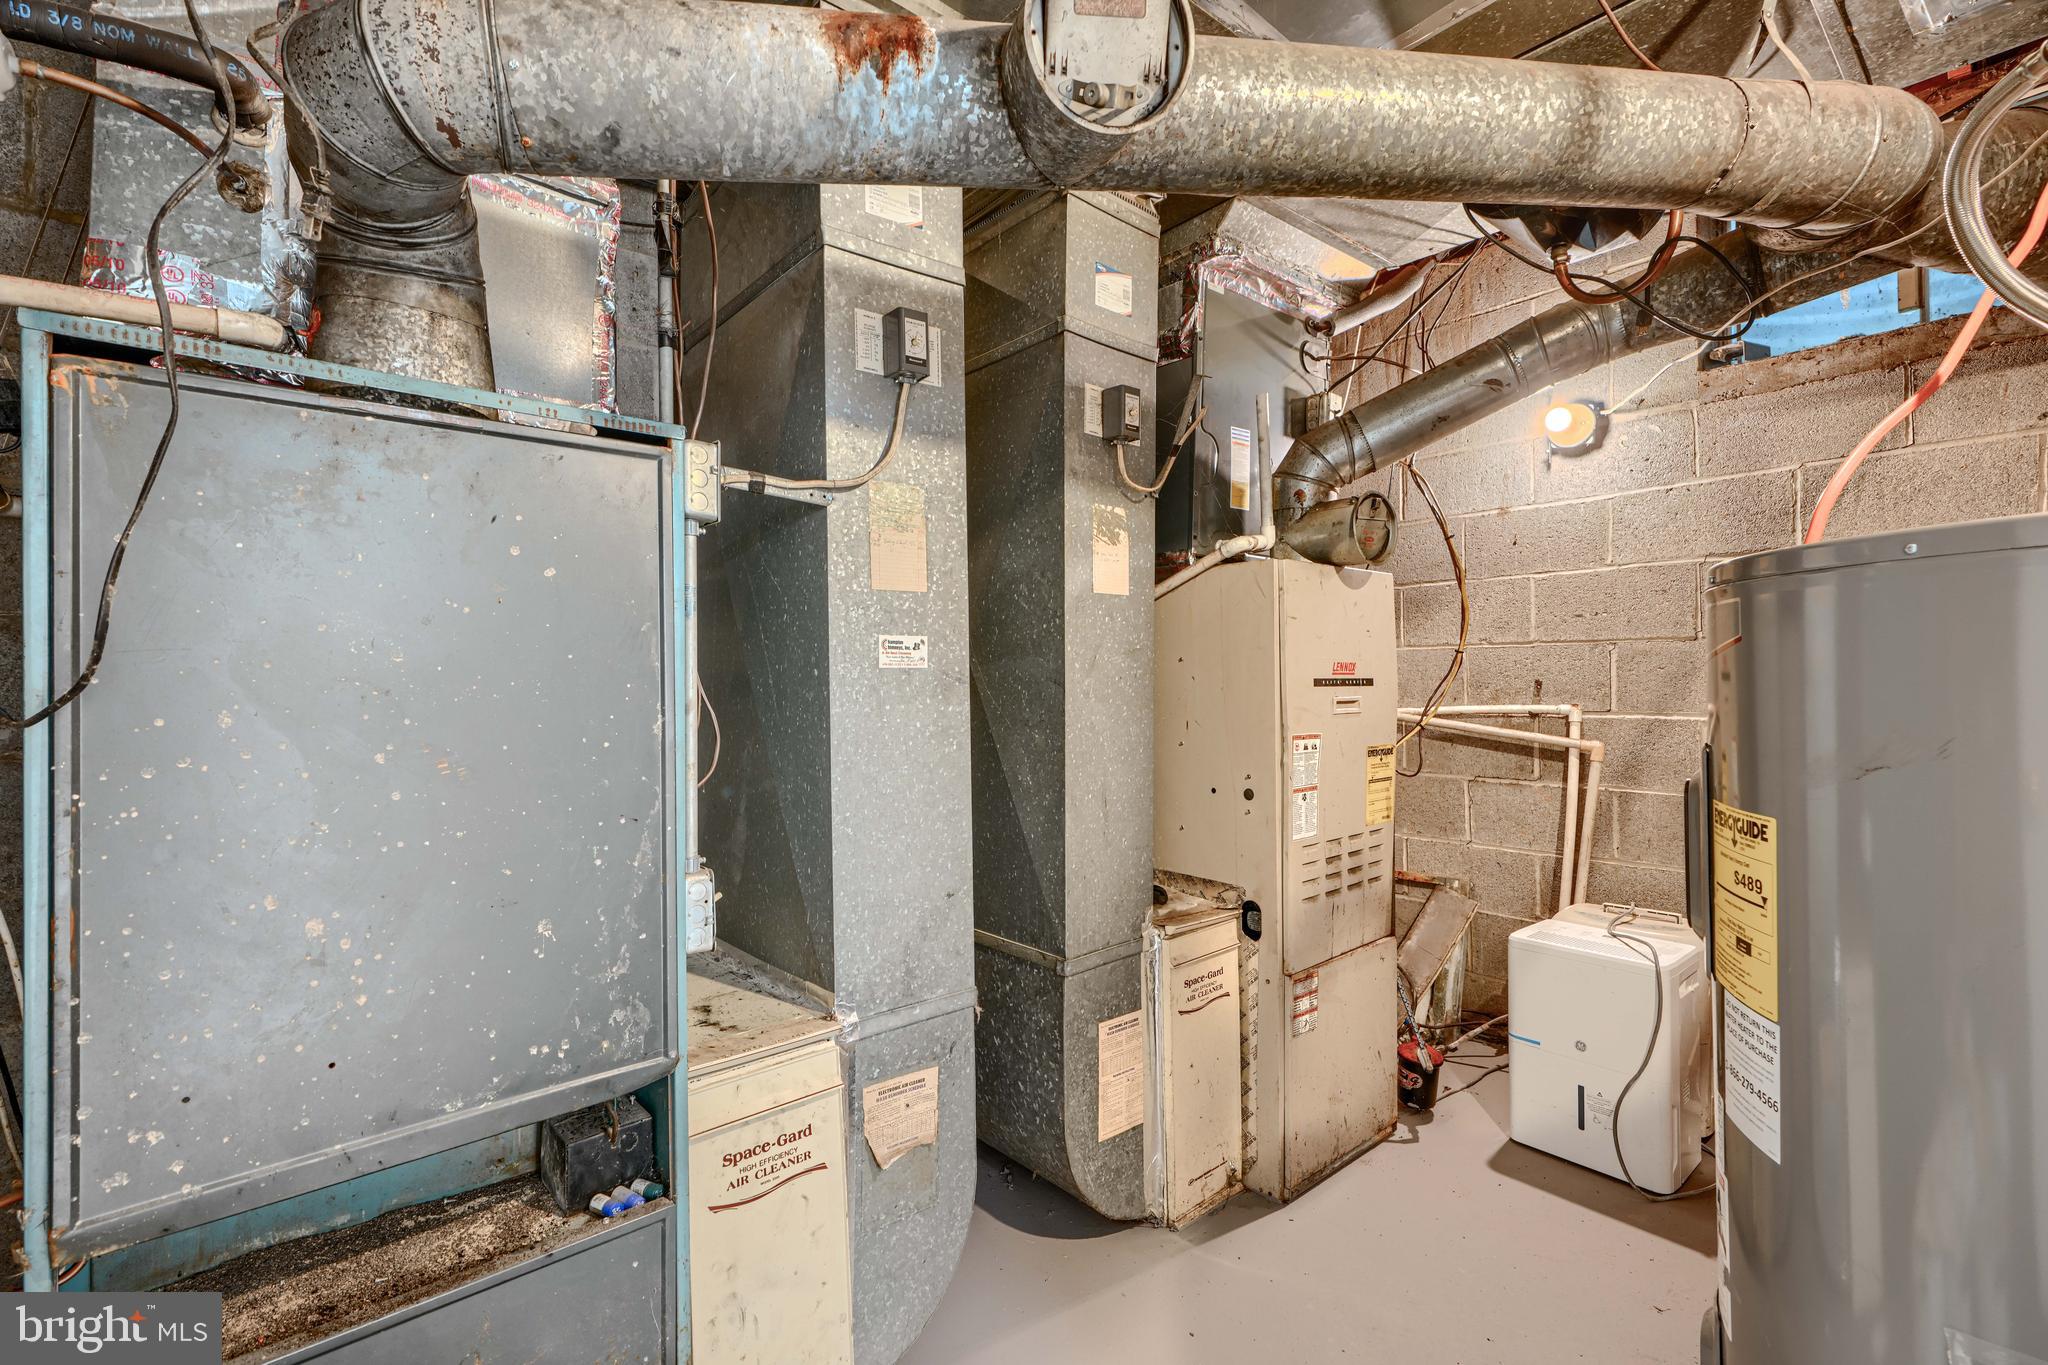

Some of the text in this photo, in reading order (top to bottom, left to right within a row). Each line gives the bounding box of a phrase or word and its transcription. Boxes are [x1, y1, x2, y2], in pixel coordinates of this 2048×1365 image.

[47, 9, 83, 31] 3/8
[93, 22, 136, 44] NOM
[145, 33, 201, 62] WALL
[1332, 661, 1357, 672] LENNOX
[1733, 870, 1763, 895] $489
[1183, 966, 1224, 988] Space-Gard
[1186, 994, 1196, 1003] AIR
[1197, 983, 1224, 998] CLEANER
[1737, 1022, 1755, 1039] HEATER
[1756, 1034, 1764, 1045] TO
[1765, 1040, 1778, 1054] THE
[1740, 1010, 1761, 1030] RETURN
[1761, 1024, 1776, 1039] THIS
[1744, 1038, 1775, 1066] PURCHASE
[722, 1123, 813, 1168] Space-Gard
[726, 1174, 750, 1191] AIR
[754, 1150, 812, 1180] CLEANER
[739, 1146, 799, 1174] HIGH EFFICIENCY
